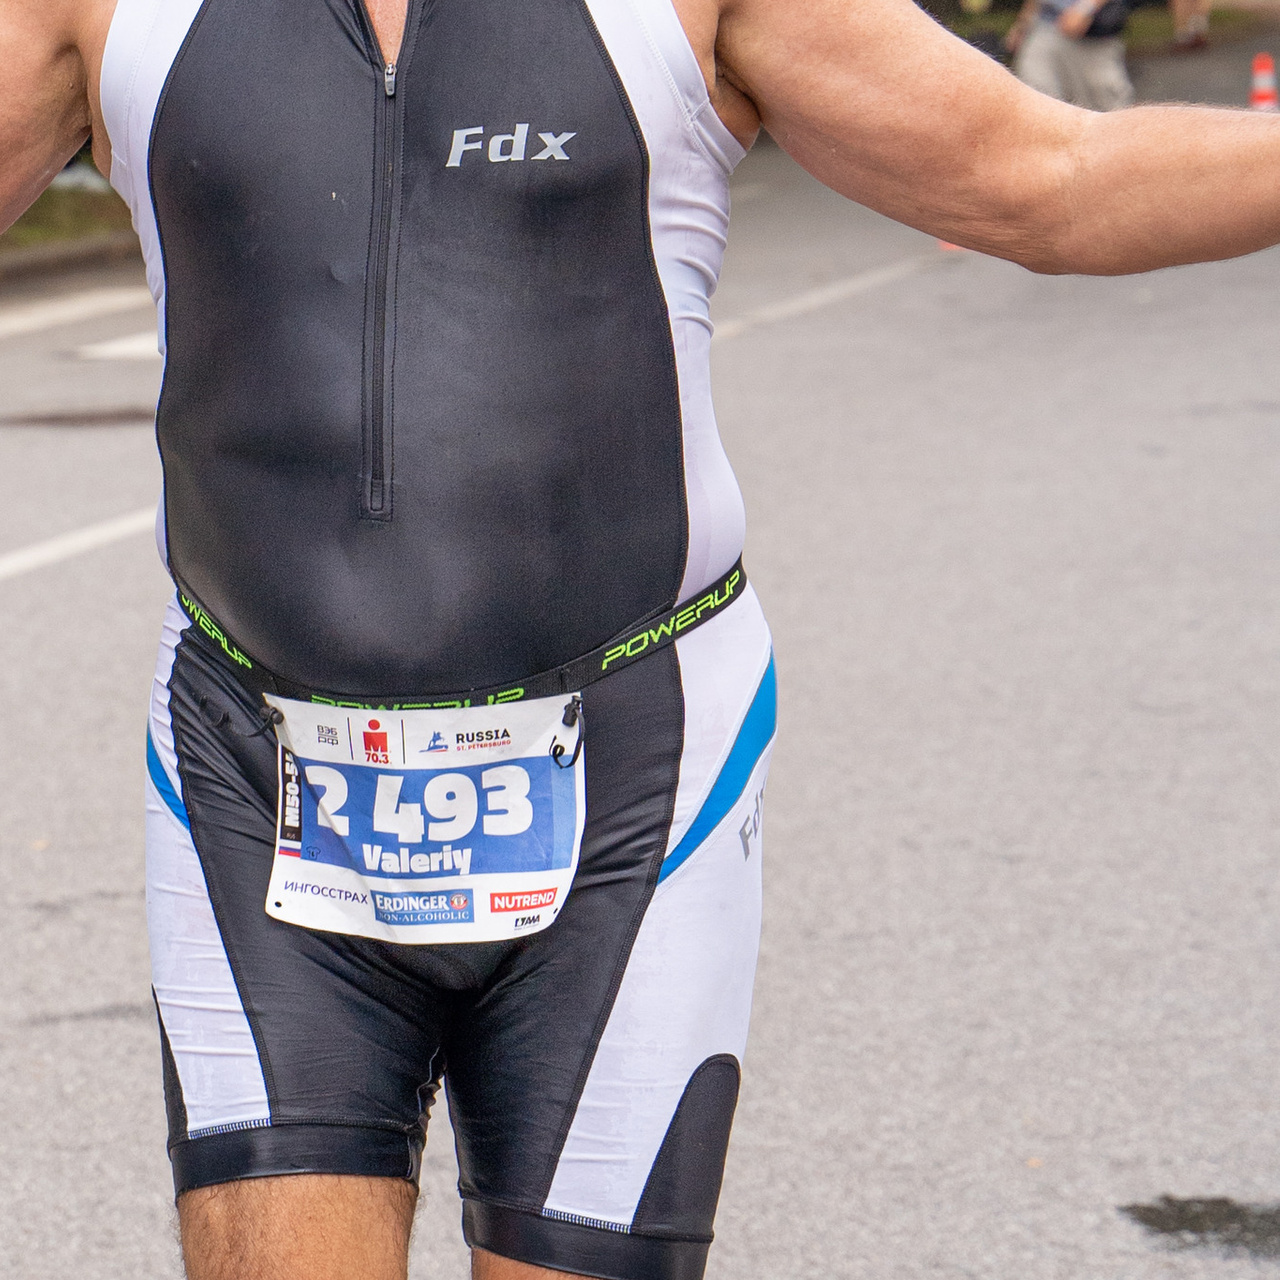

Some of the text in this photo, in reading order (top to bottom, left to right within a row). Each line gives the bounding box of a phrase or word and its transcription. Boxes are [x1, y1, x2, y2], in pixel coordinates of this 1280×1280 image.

[445, 123, 577, 167] Fdx
[601, 569, 741, 671] POWERUP
[455, 728, 511, 744] RUSSIA
[467, 739, 512, 751] PETERSBURG
[365, 752, 390, 765] 70.3
[362, 843, 473, 875] Valeriy
[283, 880, 369, 905] ИНГОССТРАХ
[494, 891, 555, 909] NUTREND
[375, 894, 450, 913] ERDINGER
[378, 910, 470, 923] NON-ALCOHOLIC
